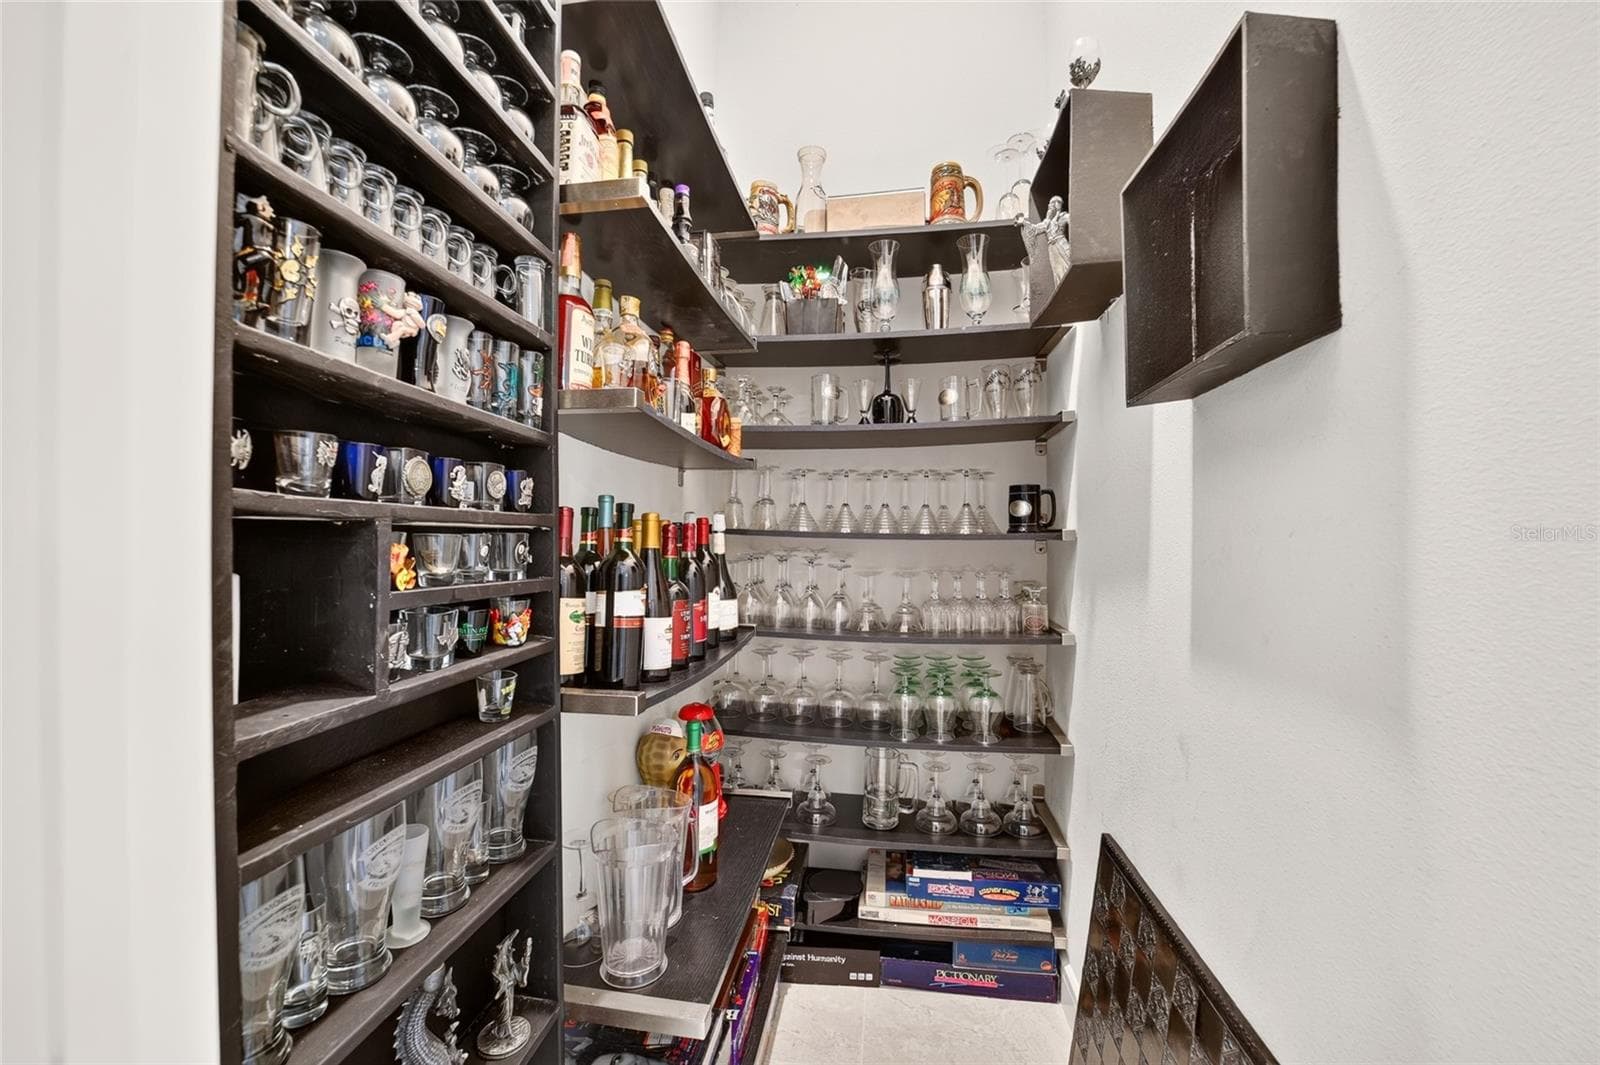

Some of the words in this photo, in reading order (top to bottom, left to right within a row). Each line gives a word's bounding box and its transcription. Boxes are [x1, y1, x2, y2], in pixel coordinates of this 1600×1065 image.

[927, 914, 977, 928] MONOPOLY
[807, 953, 846, 965] Humanity
[936, 969, 998, 983] PICTIONARY
